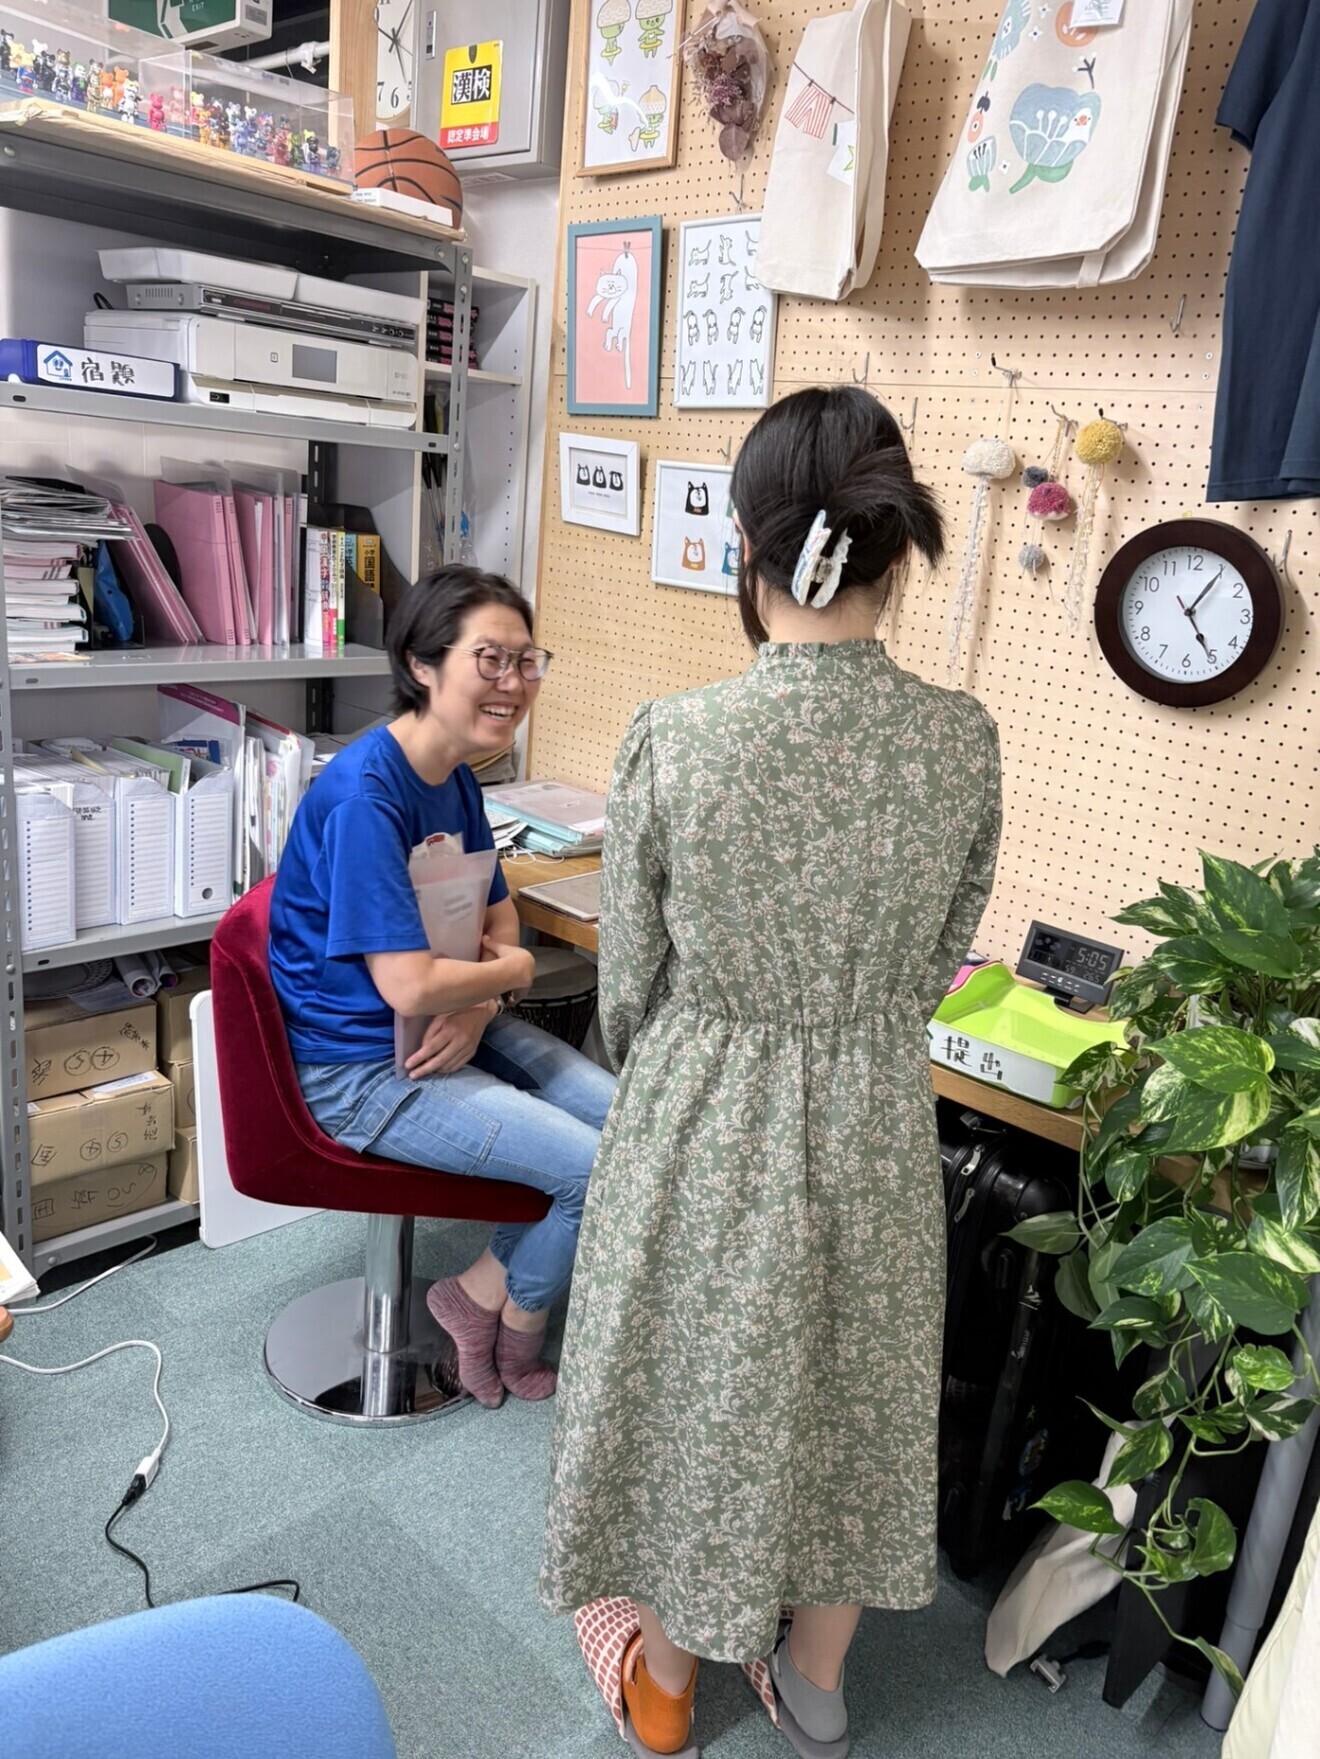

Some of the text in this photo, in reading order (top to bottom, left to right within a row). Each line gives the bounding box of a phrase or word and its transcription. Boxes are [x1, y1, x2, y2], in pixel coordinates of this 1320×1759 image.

[452, 67, 491, 104] 漢検
[391, 87, 399, 109] 6
[81, 356, 135, 386] 宿題
[1163, 560, 1177, 576] 11
[1186, 554, 1204, 571] 12
[1218, 564, 1226, 579] 1
[1143, 576, 1160, 592] 10
[1232, 582, 1244, 599] 2
[1134, 600, 1144, 616] 9
[1239, 608, 1251, 625] 3
[1141, 626, 1151, 642] 8
[1227, 635, 1238, 650] 4
[1159, 644, 1169, 659] 7
[1206, 649, 1218, 664] 5
[1181, 653, 1191, 668] 6
[1076, 947, 1108, 971] 5:05
[941, 1035, 1004, 1081] 提出
